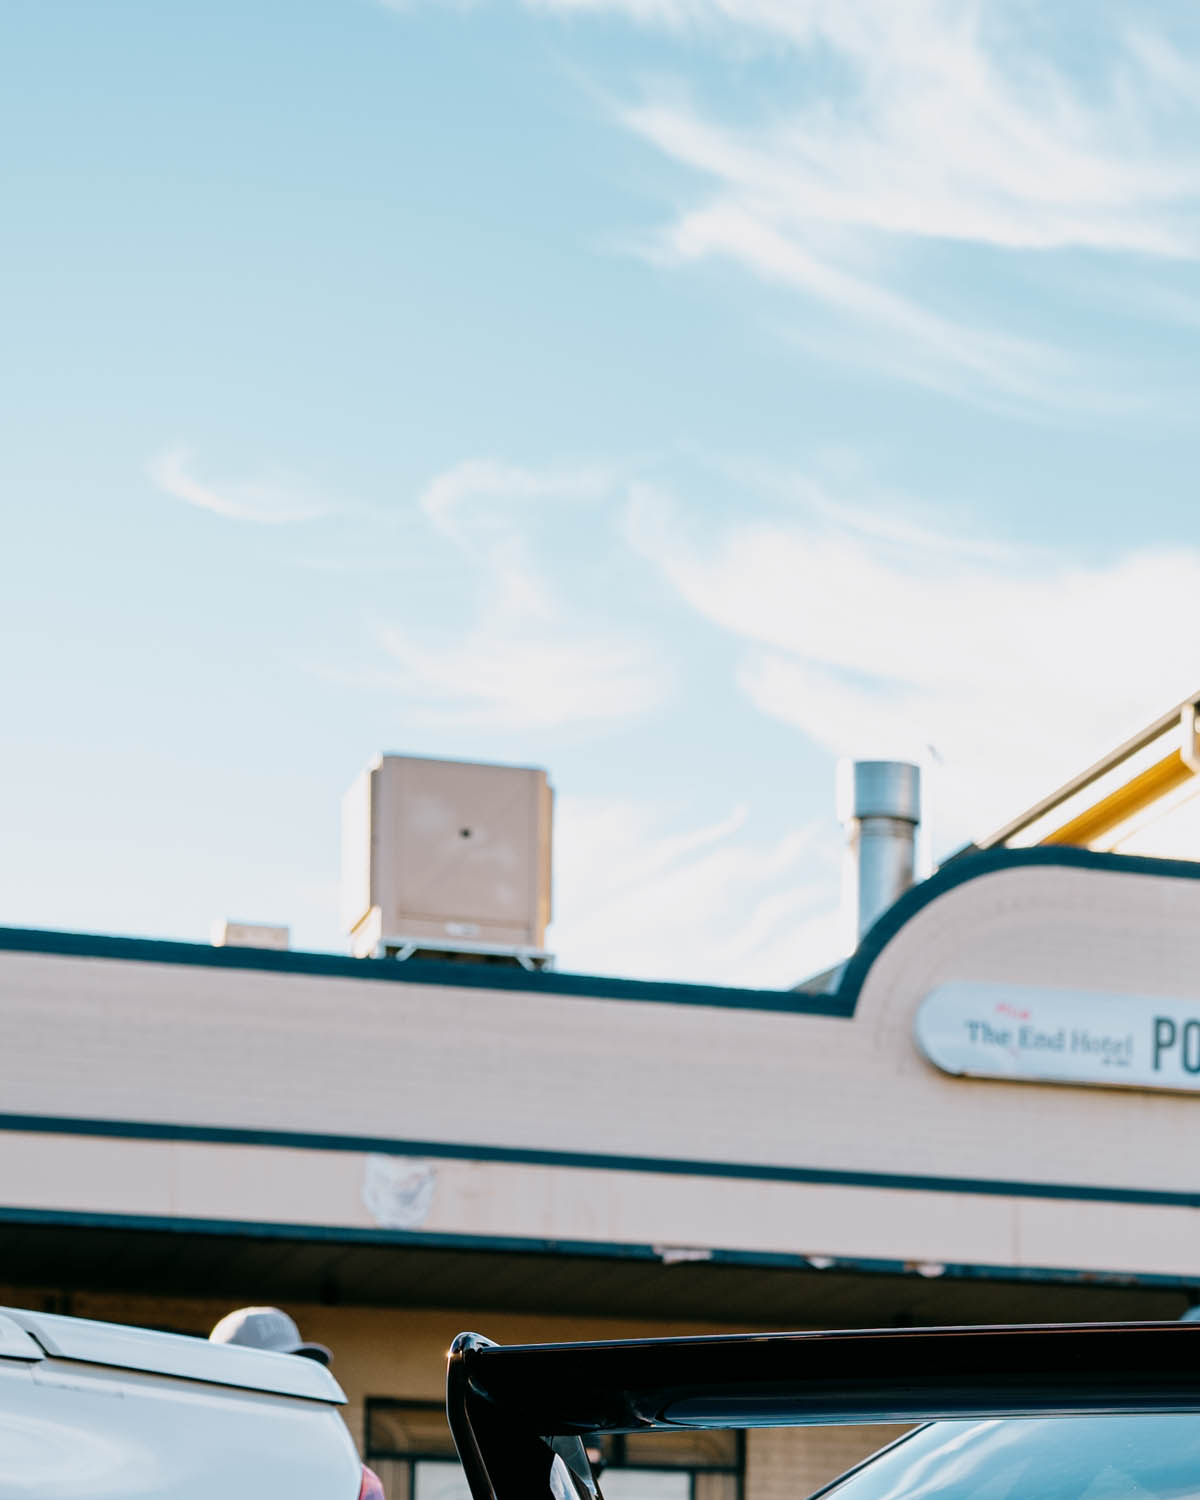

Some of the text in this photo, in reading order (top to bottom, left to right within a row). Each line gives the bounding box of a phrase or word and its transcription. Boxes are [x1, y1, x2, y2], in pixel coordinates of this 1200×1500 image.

[965, 1019, 1012, 1046] The
[1018, 1025, 1066, 1053] End
[1070, 1029, 1134, 1056] Hotel
